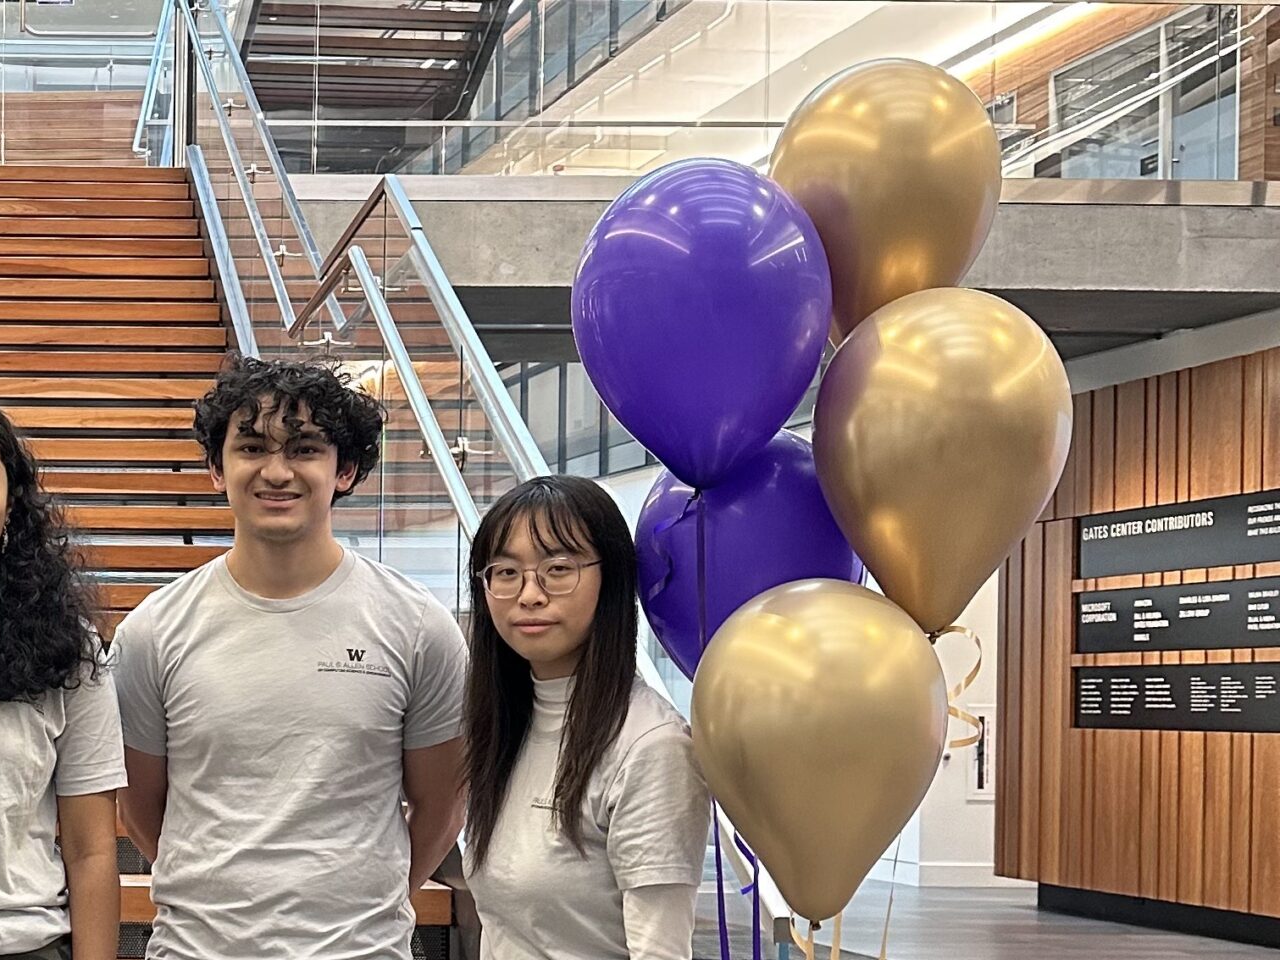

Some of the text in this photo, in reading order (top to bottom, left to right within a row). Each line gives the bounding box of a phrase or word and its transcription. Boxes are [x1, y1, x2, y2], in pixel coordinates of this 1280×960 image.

[1082, 511, 1214, 541] GATES CENTER CONTRIBUTORS
[346, 648, 366, 661] W
